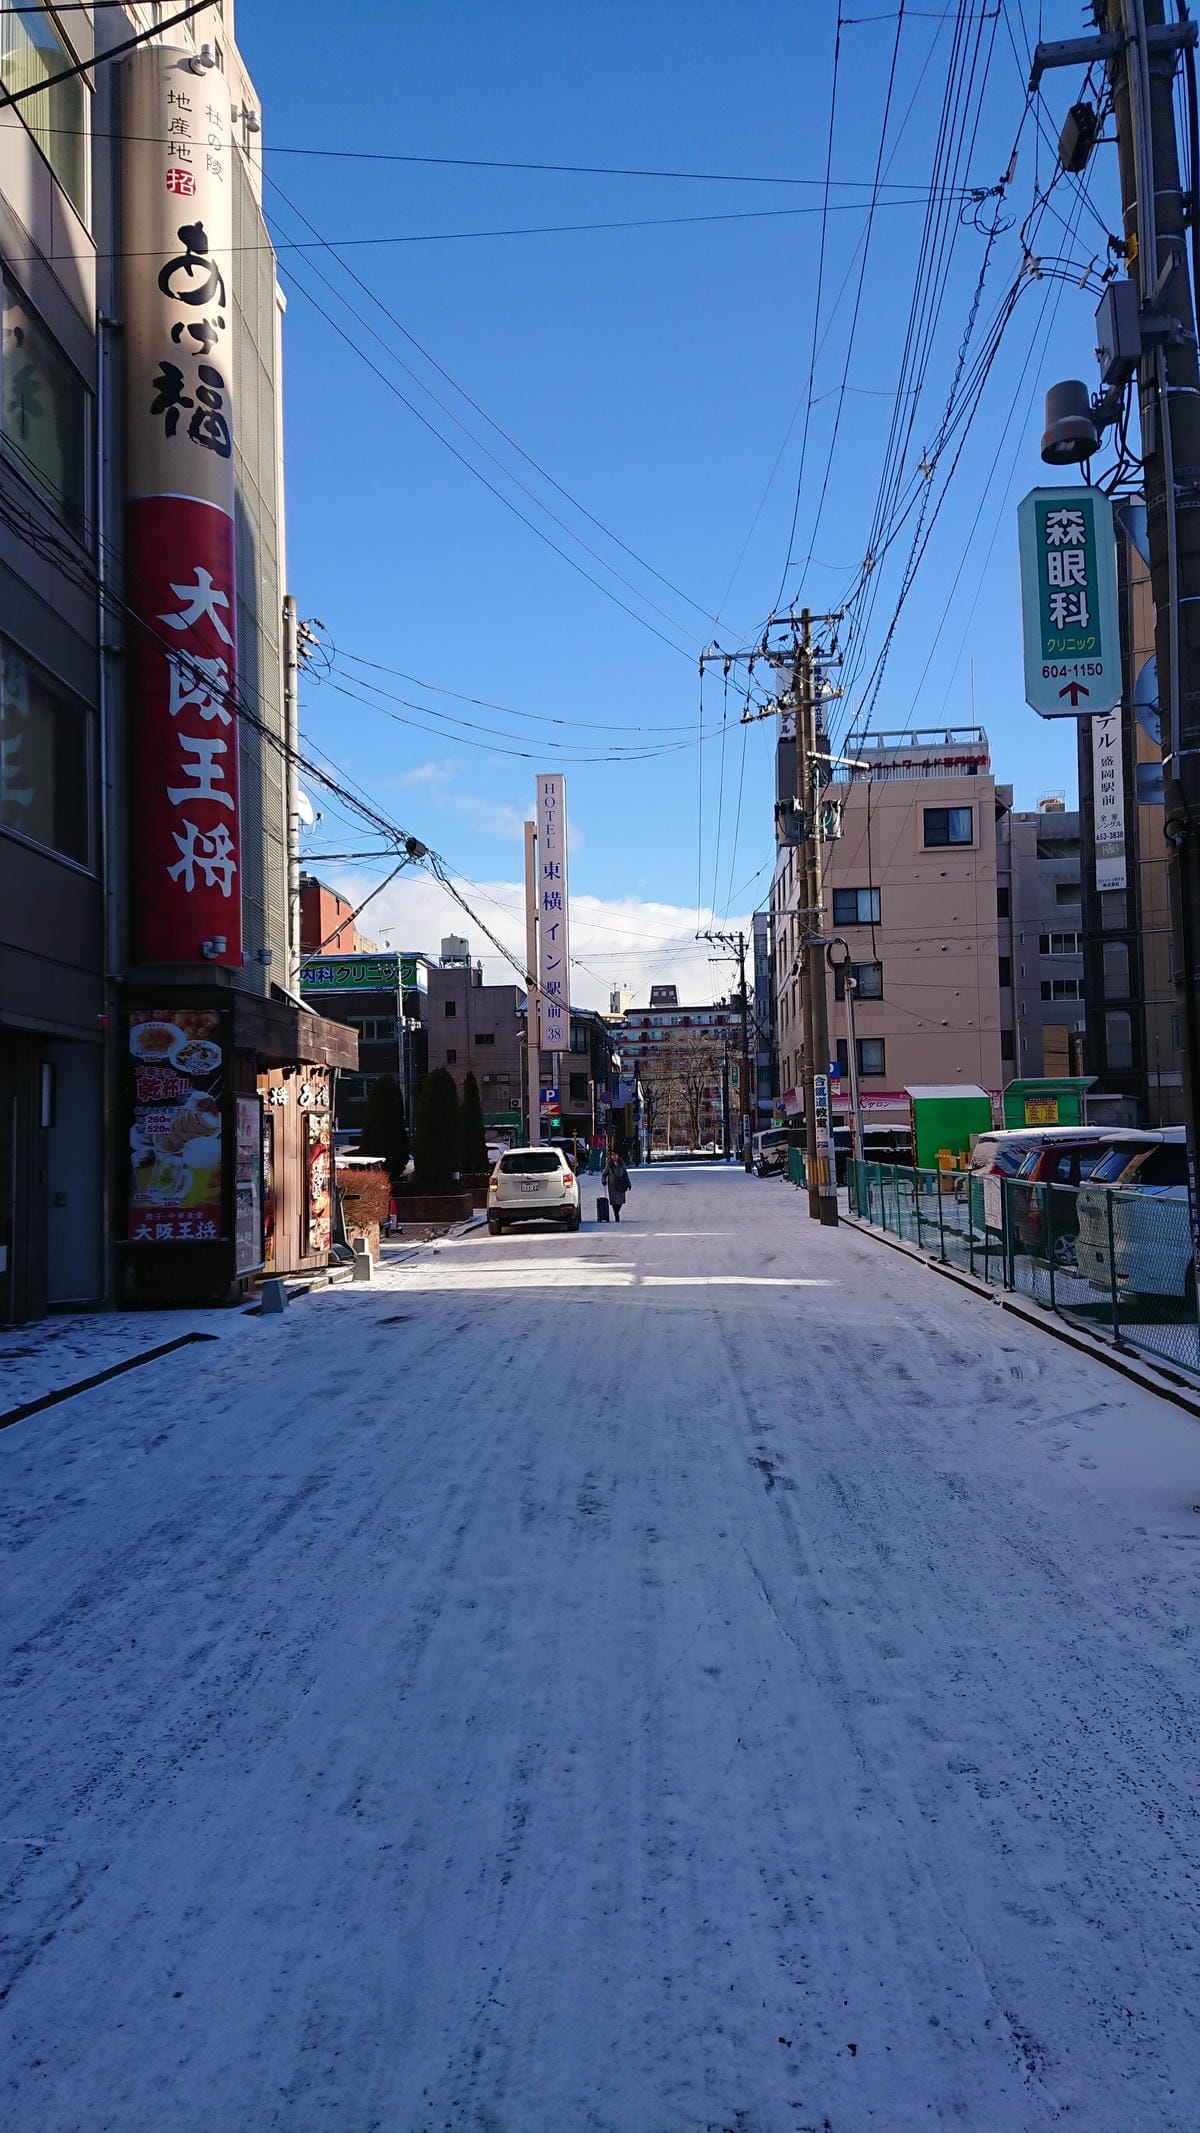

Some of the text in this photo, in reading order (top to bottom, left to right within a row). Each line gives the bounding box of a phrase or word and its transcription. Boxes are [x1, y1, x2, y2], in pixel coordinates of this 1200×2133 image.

[1046, 508, 1090, 630] 森眼科
[1041, 662, 1103, 679] 604-1150
[1047, 635, 1096, 653] クリニック
[156, 566, 237, 898] 大阪王将
[1101, 756, 1115, 807] 盛岡駅前
[544, 783, 556, 849] HOTEL
[542, 861, 562, 1018] 東横イン駅前
[132, 1221, 217, 1241] 大阪王将
